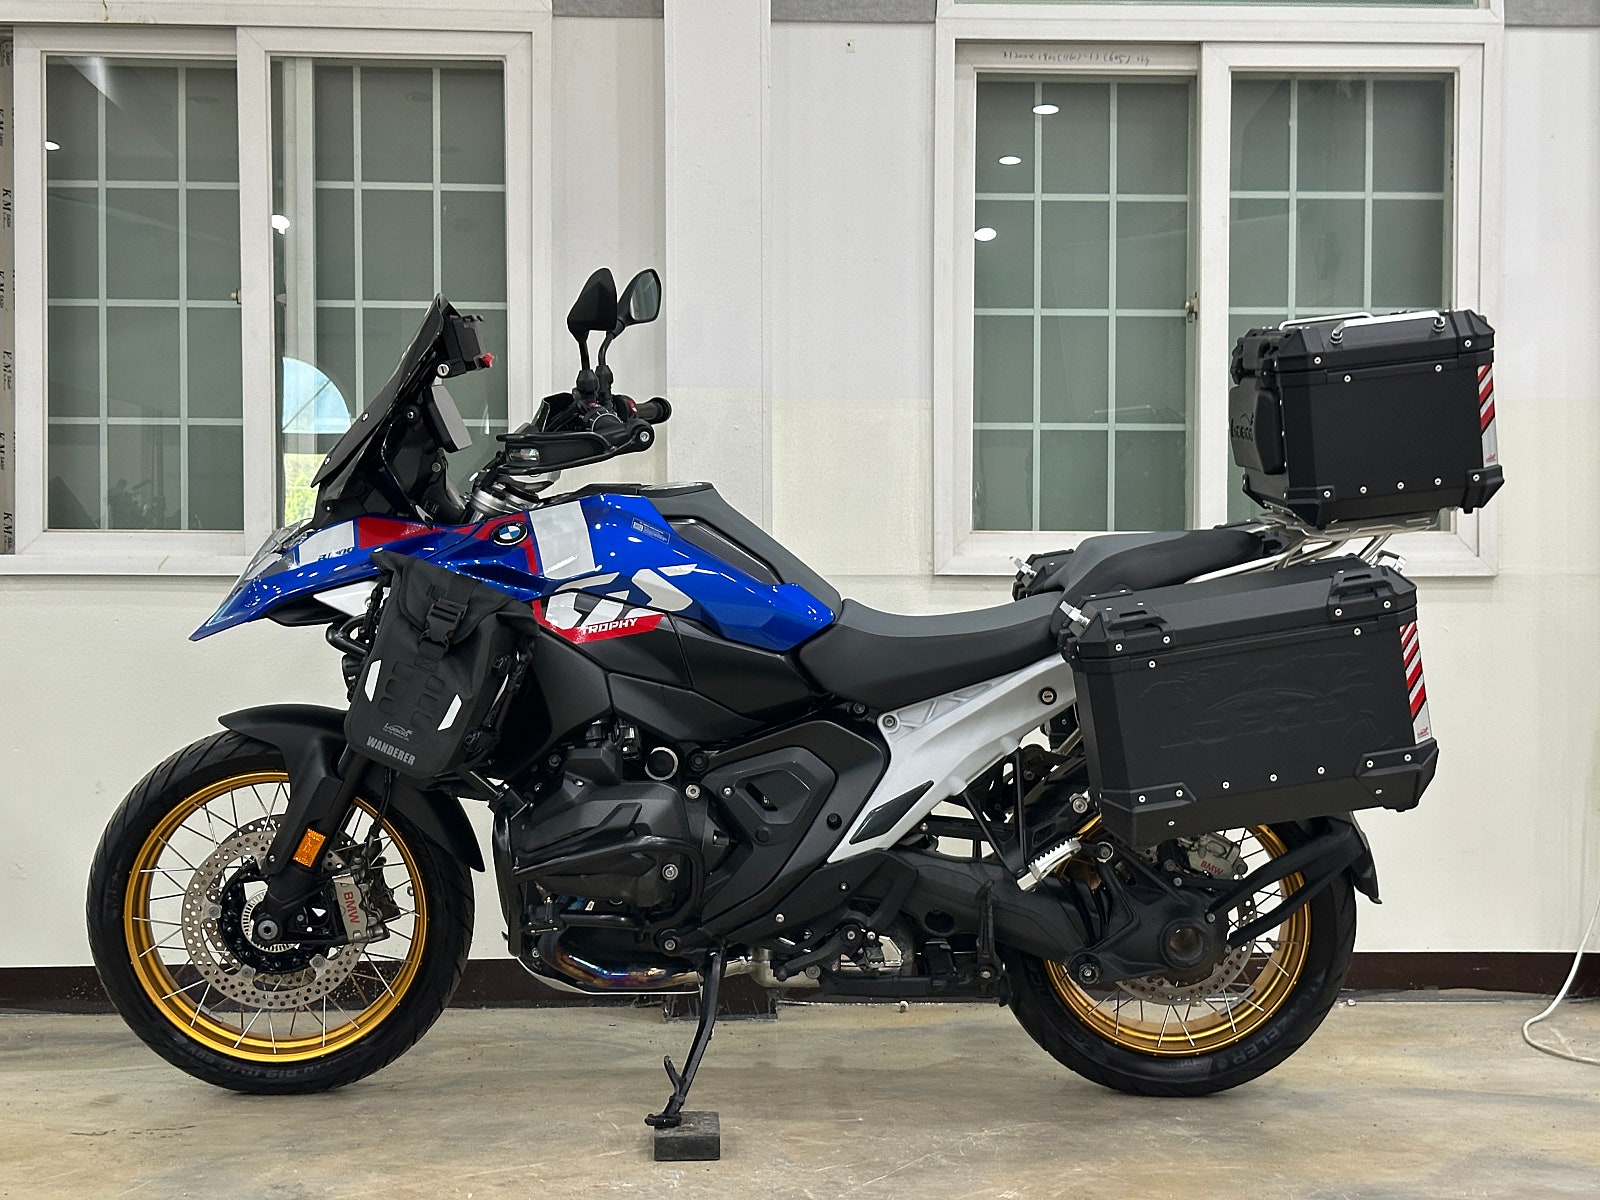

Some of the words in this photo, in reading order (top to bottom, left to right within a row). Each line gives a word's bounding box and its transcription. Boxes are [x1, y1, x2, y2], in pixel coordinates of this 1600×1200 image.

[579, 617, 638, 635] TROPHY
[366, 735, 416, 766] WANDERER
[1200, 859, 1224, 876] BMW
[343, 890, 361, 924] BMW
